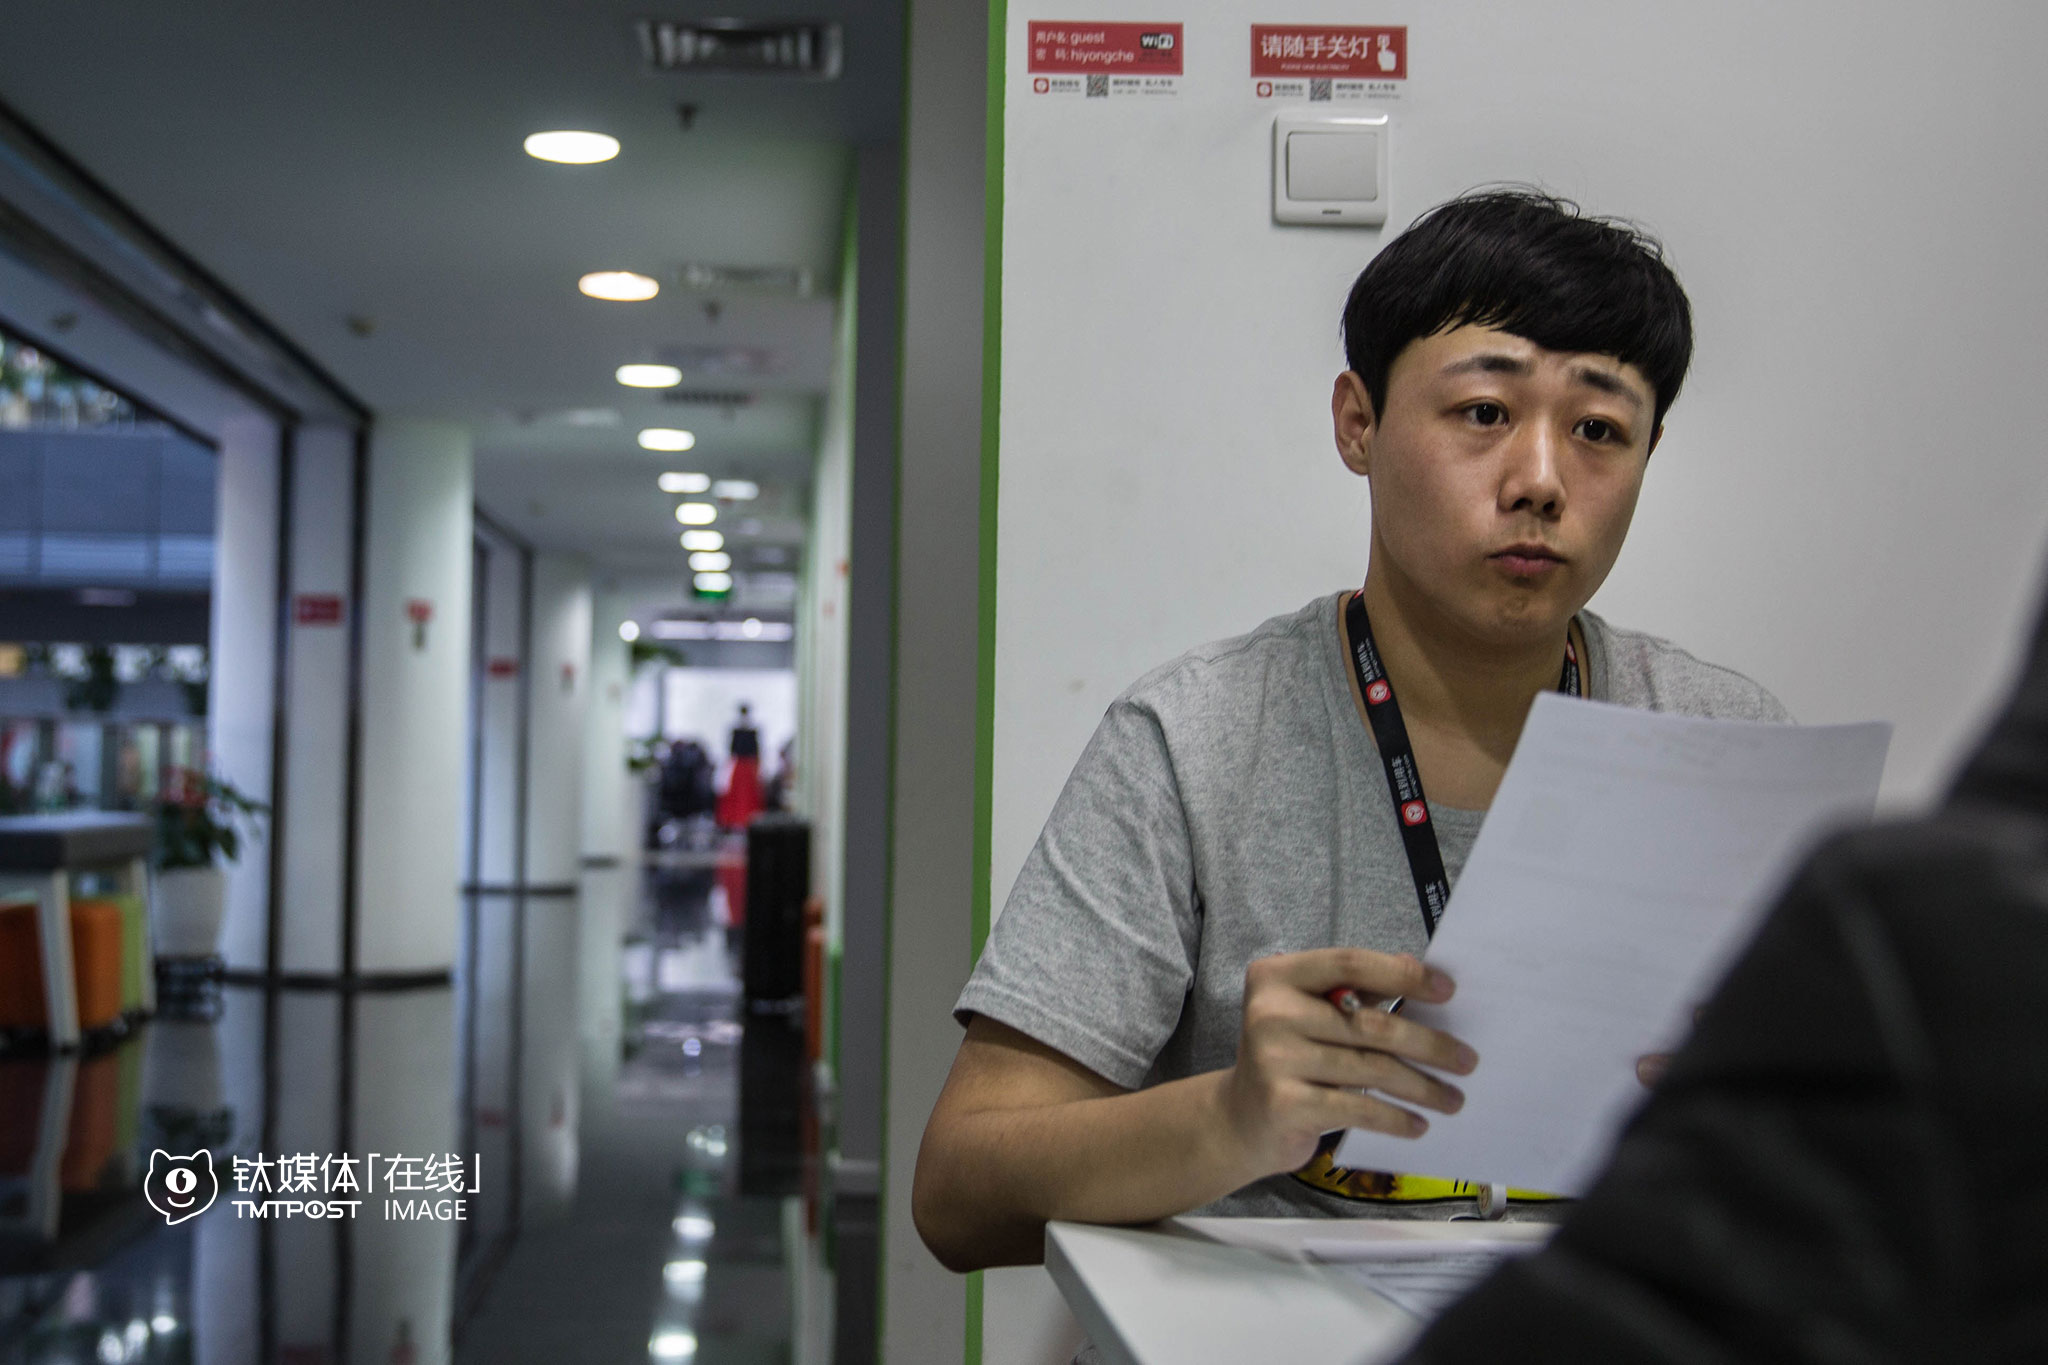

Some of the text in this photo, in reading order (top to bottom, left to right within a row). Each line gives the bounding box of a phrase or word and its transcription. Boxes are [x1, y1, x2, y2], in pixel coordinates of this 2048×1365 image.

[1070, 32, 1105, 46] guest
[1261, 34, 1371, 59] 请随手关灯
[1070, 49, 1135, 65] hiyongche
